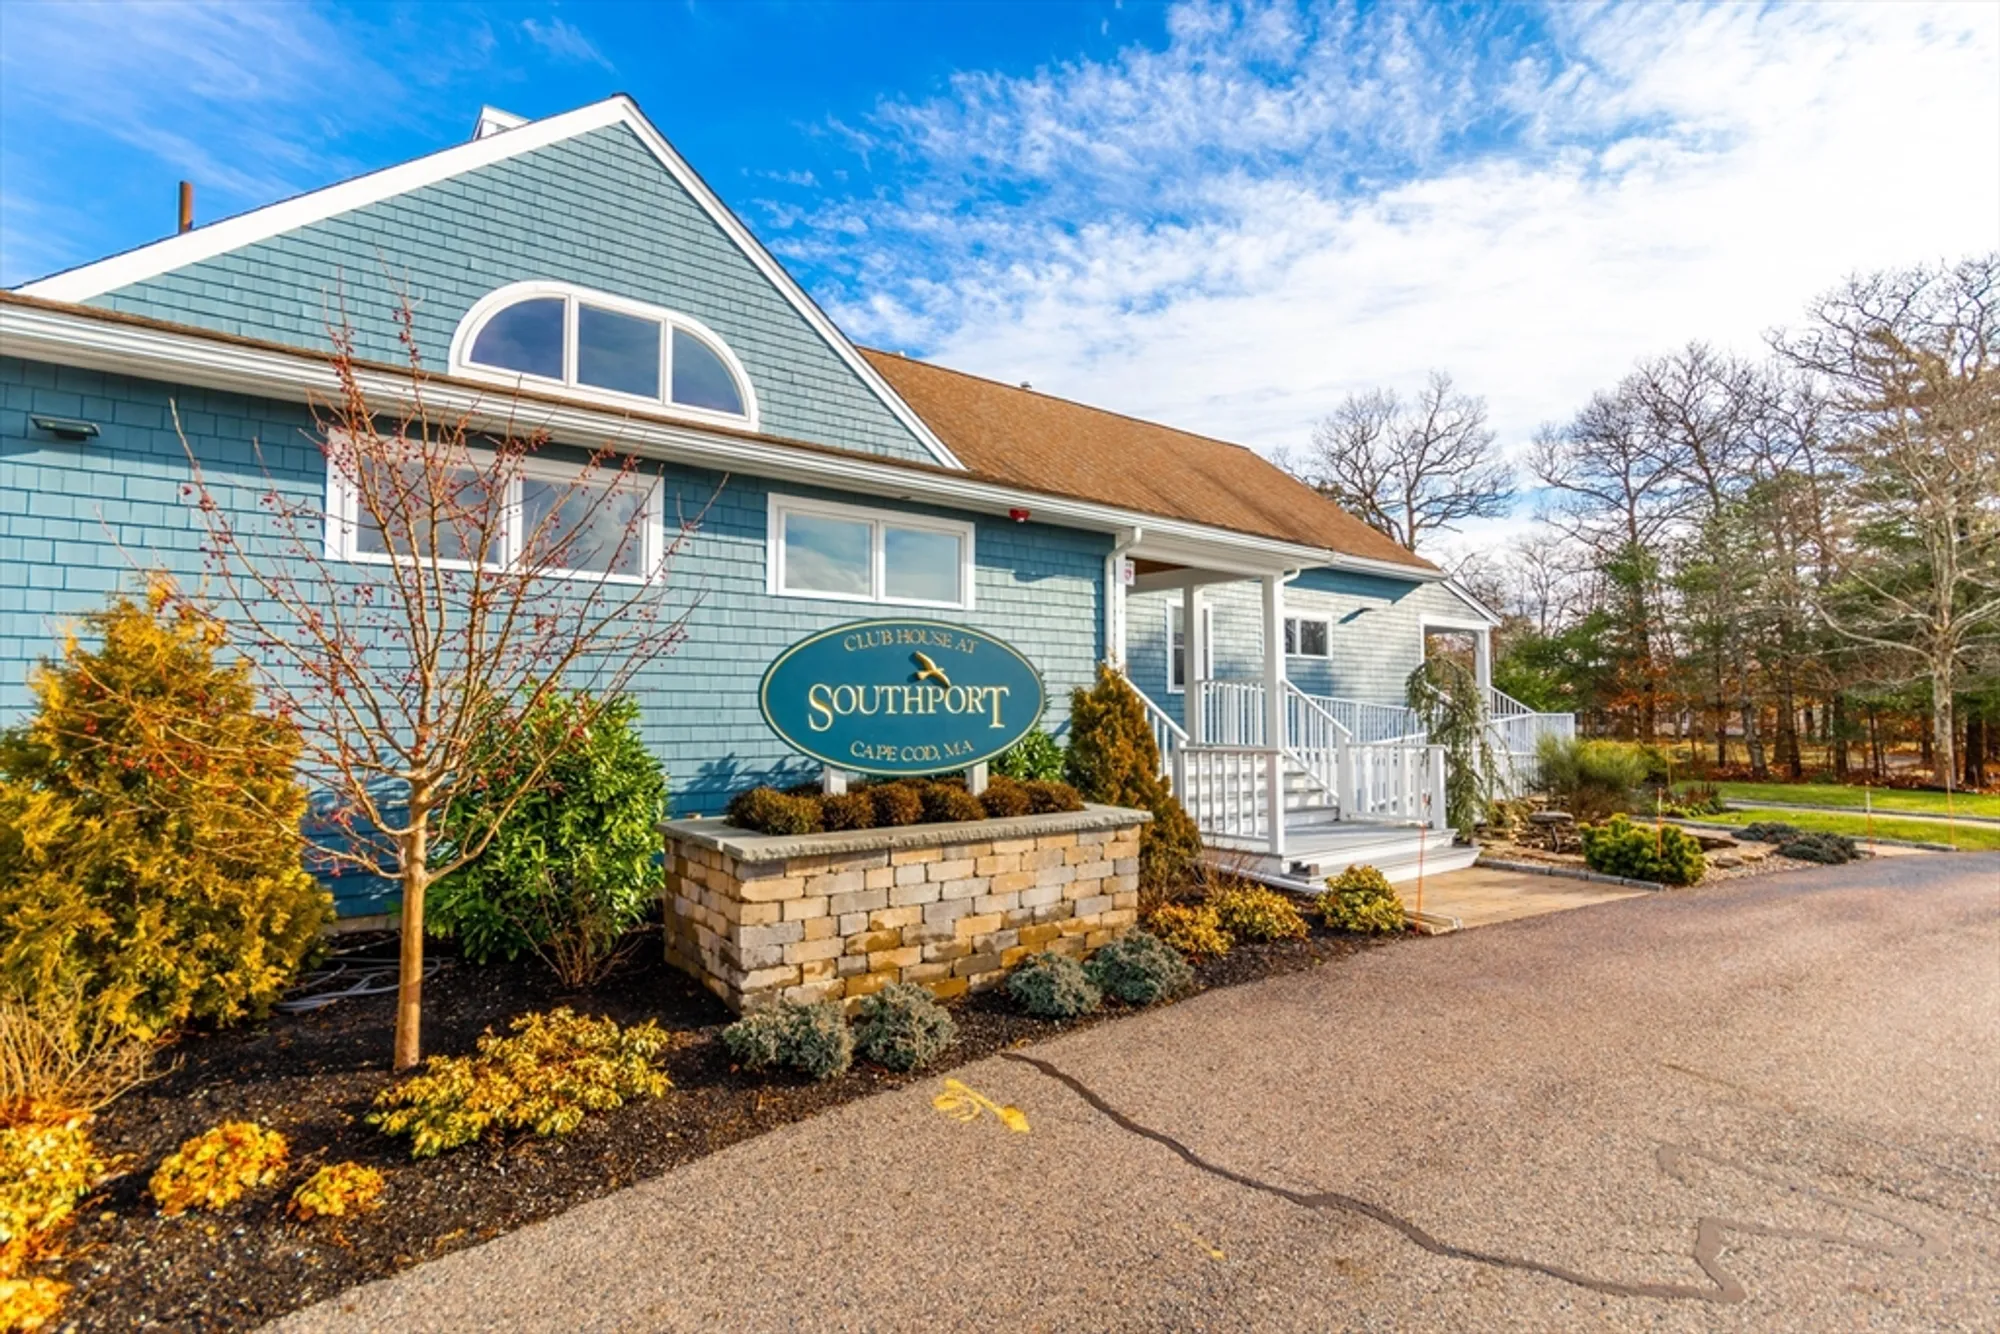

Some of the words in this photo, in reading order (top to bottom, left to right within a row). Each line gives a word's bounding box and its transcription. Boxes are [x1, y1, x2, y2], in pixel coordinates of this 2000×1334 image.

[843, 629, 894, 652] CLUB
[896, 629, 953, 649] HOUSE
[955, 638, 978, 654] AT
[808, 683, 1010, 732] SOUTHPORT
[850, 740, 898, 762] CAPE
[901, 744, 941, 762] COD,
